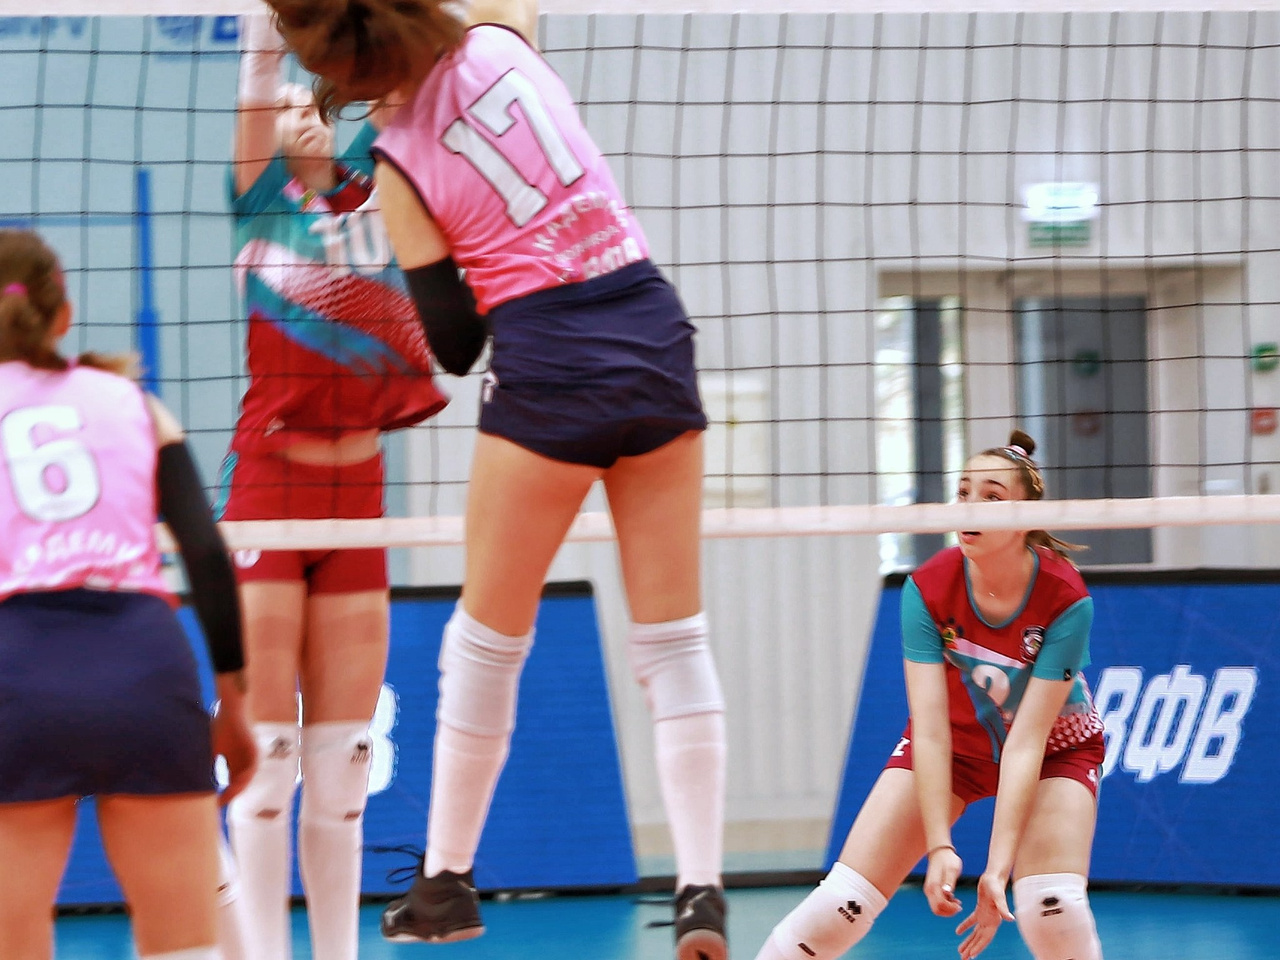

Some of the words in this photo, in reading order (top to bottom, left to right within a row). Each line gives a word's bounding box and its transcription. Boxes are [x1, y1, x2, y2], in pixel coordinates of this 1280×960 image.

[444, 68, 585, 228] 17
[0, 405, 101, 522] 6
[1092, 664, 1259, 784] ВФВ
